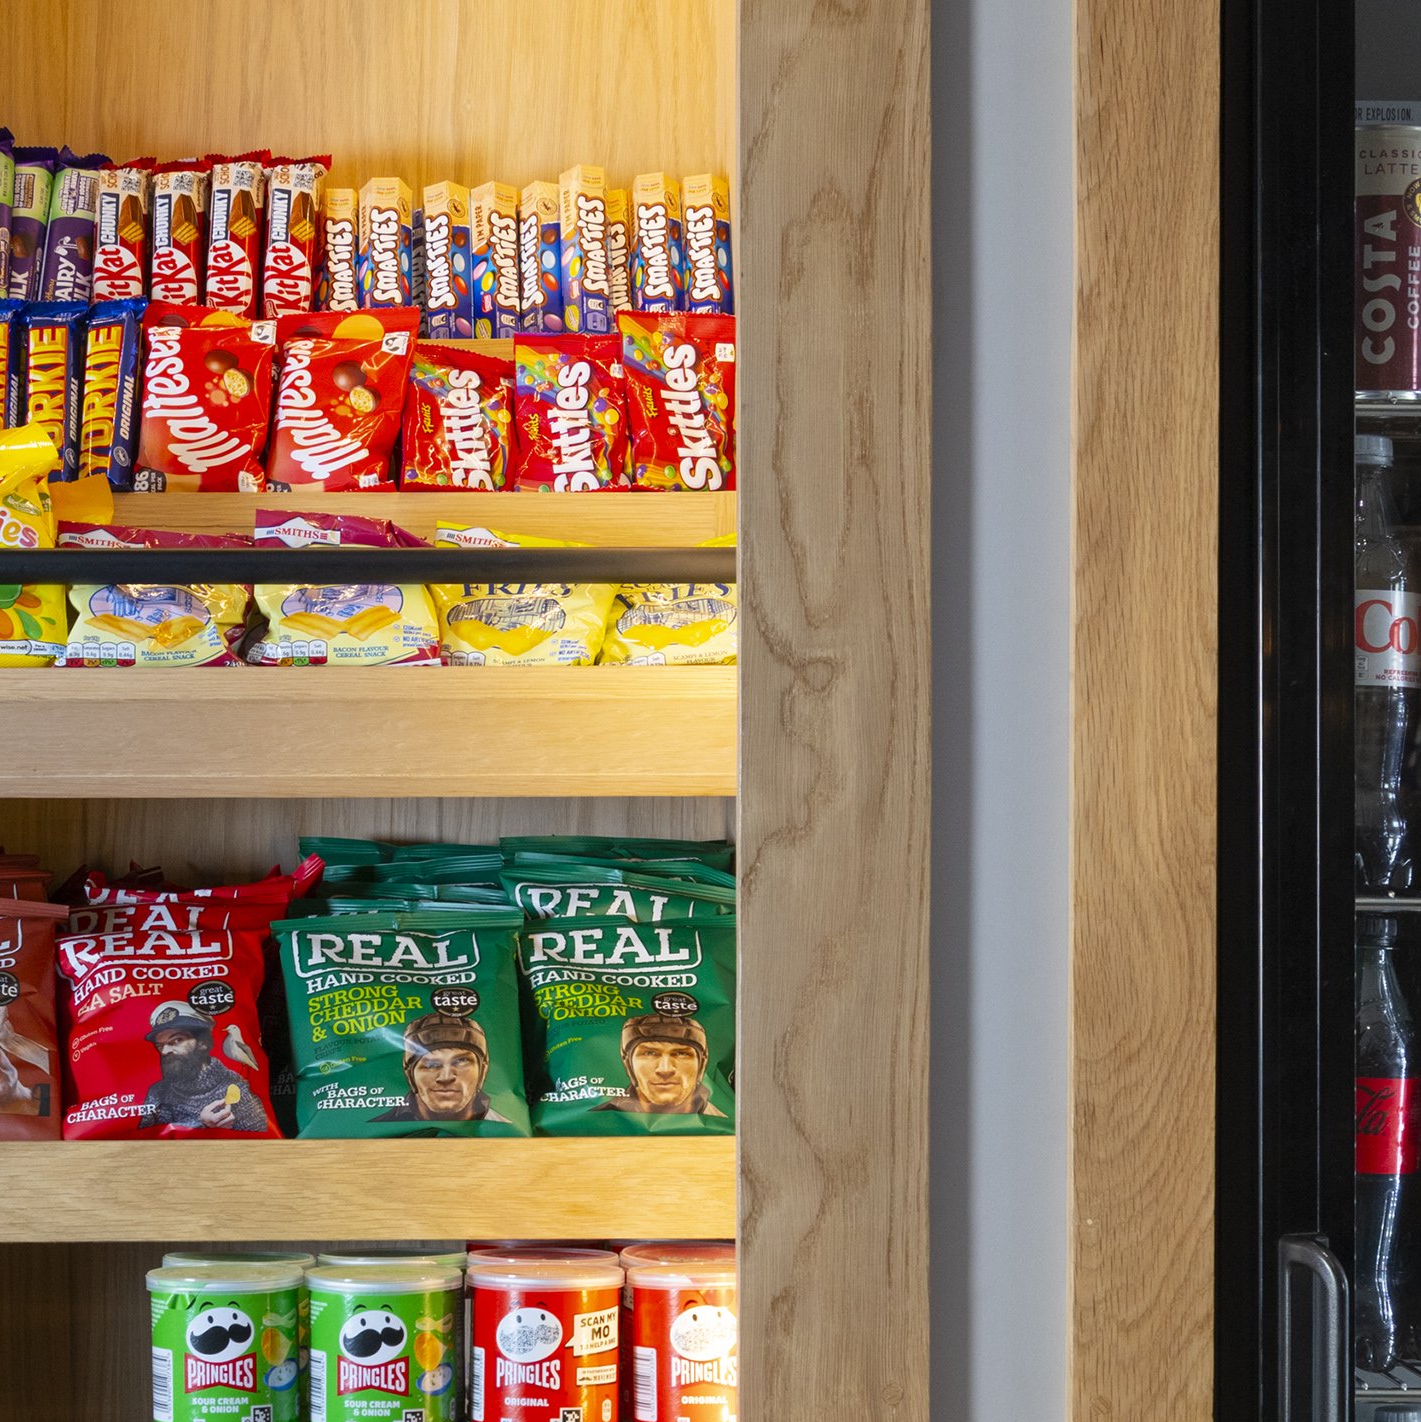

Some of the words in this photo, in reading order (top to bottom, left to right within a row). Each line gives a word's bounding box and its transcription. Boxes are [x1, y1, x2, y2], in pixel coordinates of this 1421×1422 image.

[1366, 108, 1413, 120] EXPLOSION.
[1363, 162, 1419, 176] LATTE
[100, 193, 118, 244] CHUNKY
[212, 189, 230, 241] CHUNKY
[371, 208, 403, 303] SMARTIES
[578, 196, 609, 295] SMARTIES
[685, 205, 721, 300] SMARTIES
[1361, 209, 1402, 365] COSTA
[1406, 244, 1421, 330] COFFEE
[120, 375, 135, 440] ORIGINAL
[662, 343, 724, 491] Skittles
[274, 527, 320, 539] SMITHS
[61, 930, 221, 977] REAL
[306, 931, 468, 967] REAL
[529, 927, 690, 965] REAL
[132, 964, 229, 980] COOKED
[306, 973, 374, 995] HAND
[380, 971, 477, 985] COOKED
[530, 971, 597, 989] HAND
[601, 972, 698, 988] COOKED
[308, 984, 398, 1013] STRONG
[309, 996, 423, 1027] CHEDDAR
[312, 1025, 327, 1043] &
[332, 1010, 406, 1037] ONION
[580, 1315, 605, 1328] SCAN
[607, 1312, 616, 1322] MY
[591, 1326, 610, 1340] MO
[187, 1358, 254, 1389] PRINGLES
[339, 1360, 406, 1392] PRINGLES
[496, 1358, 560, 1390] PRINGLES
[201, 1406, 208, 1414] &
[210, 1405, 239, 1414] ONION
[217, 1397, 249, 1405] CREAM
[504, 1398, 549, 1407] ORIGINAL
